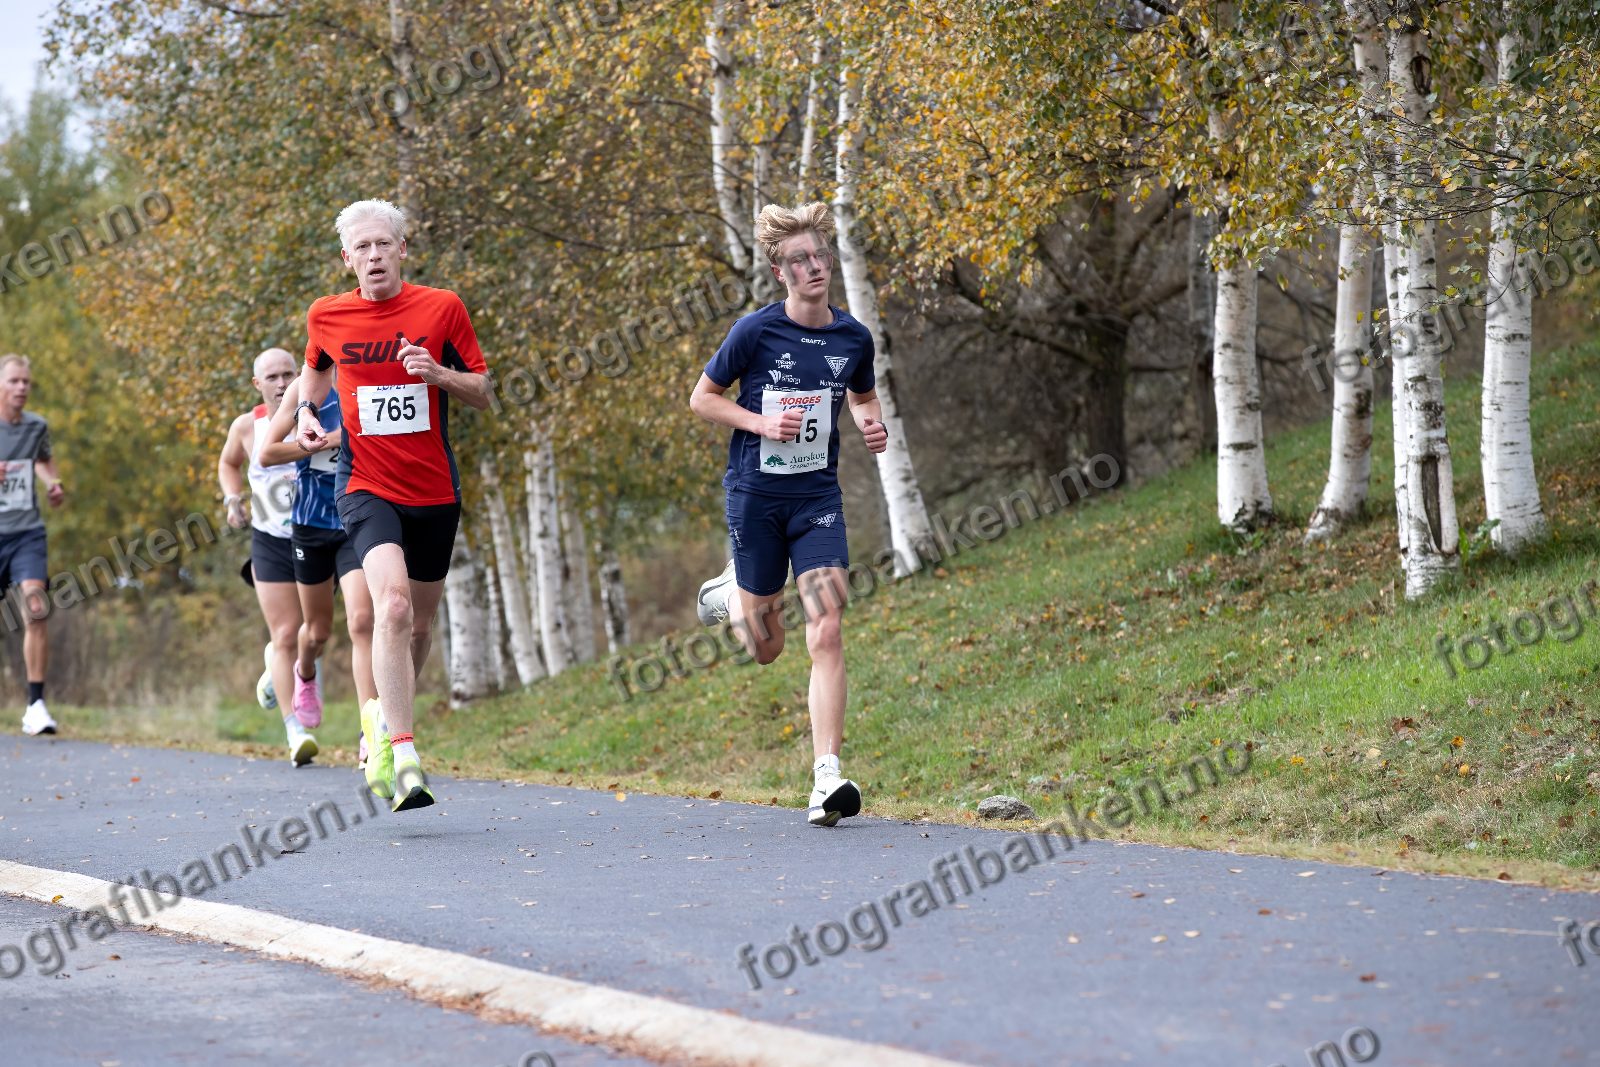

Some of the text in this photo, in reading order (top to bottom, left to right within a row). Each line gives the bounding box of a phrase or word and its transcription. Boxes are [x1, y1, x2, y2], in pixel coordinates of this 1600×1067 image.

[780, 395, 822, 406] NORGES
[371, 396, 416, 422] 765
[790, 451, 826, 465] Aurskog
